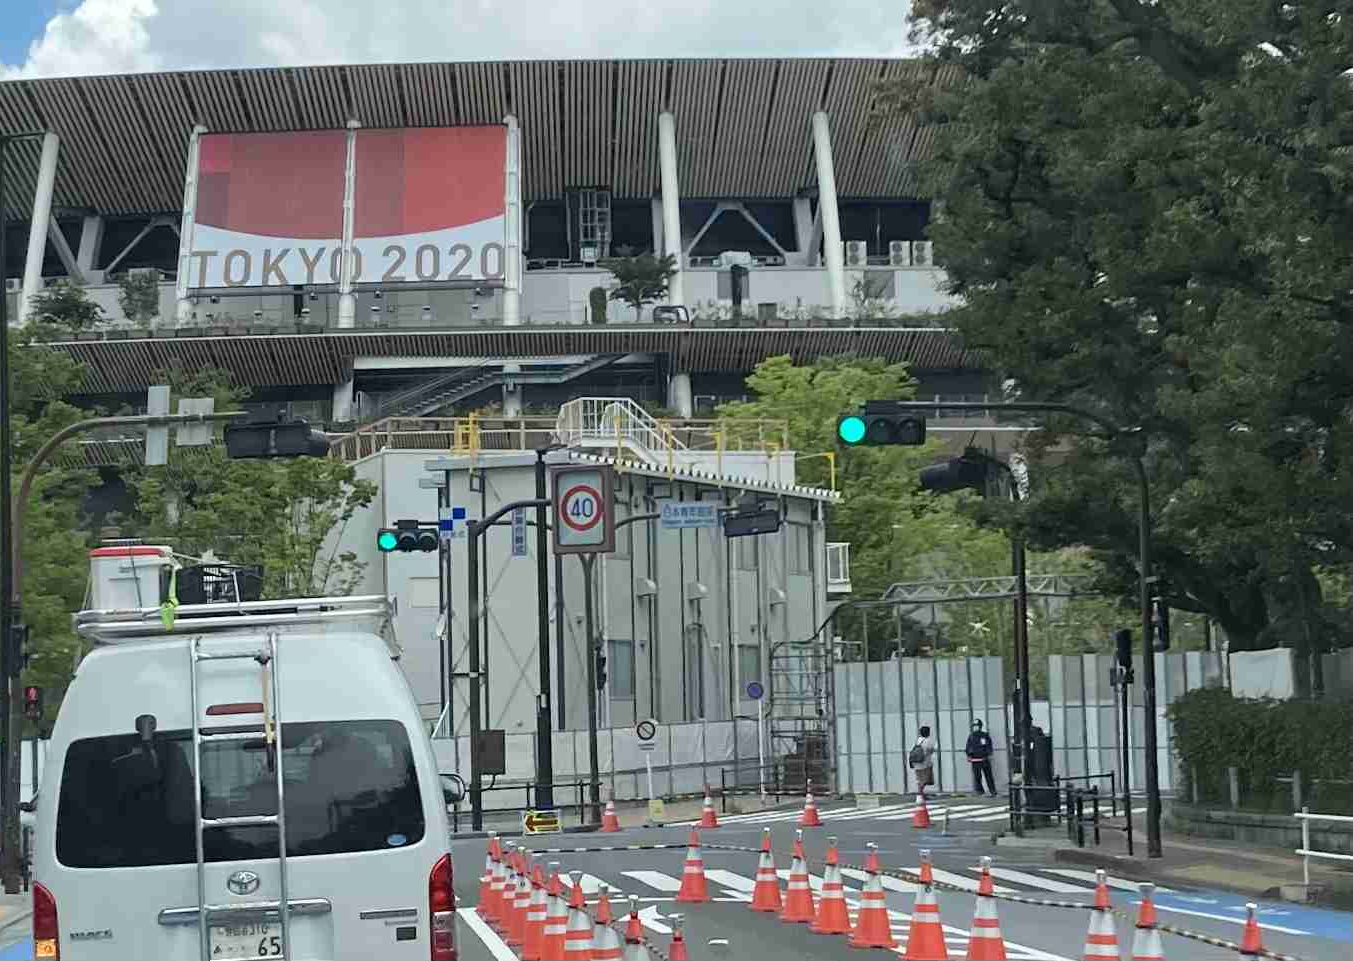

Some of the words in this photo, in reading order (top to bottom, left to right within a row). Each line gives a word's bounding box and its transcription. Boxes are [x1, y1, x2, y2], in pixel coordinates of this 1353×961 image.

[191, 246, 362, 289] TOKYO
[381, 242, 505, 282] 2020
[570, 497, 594, 519] 40
[258, 936, 281, 956] 65
